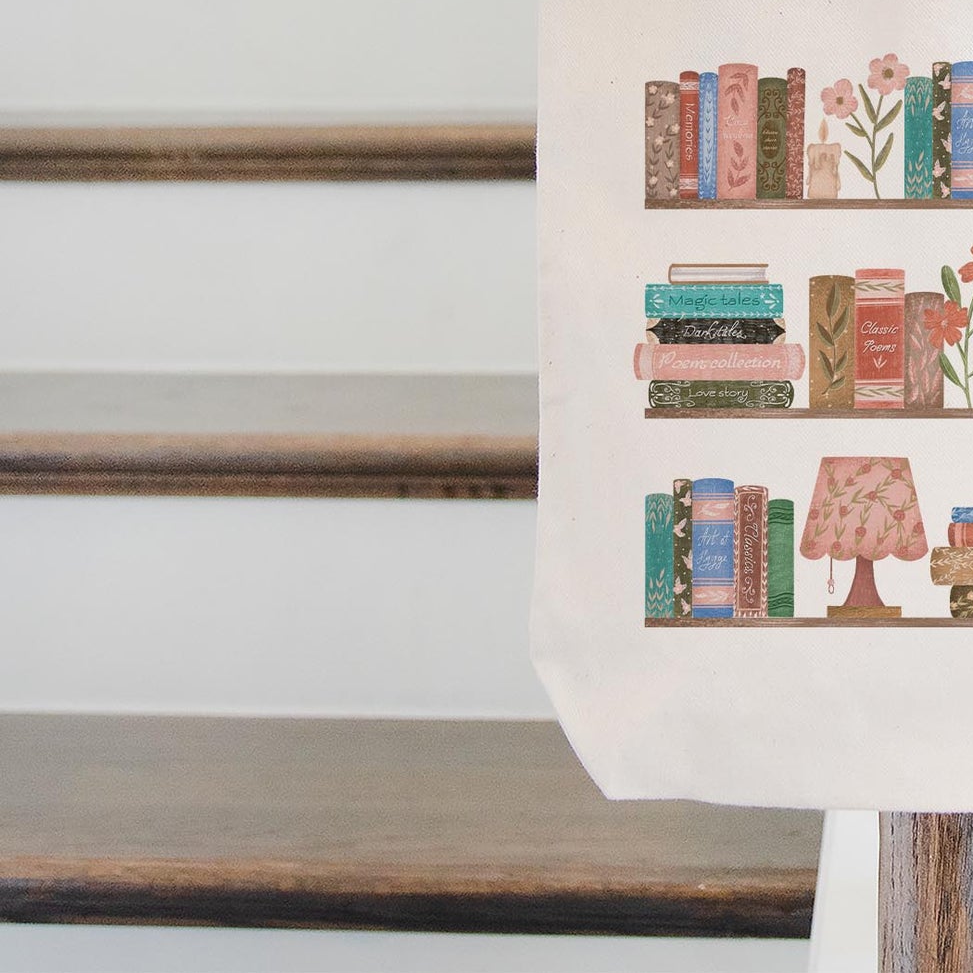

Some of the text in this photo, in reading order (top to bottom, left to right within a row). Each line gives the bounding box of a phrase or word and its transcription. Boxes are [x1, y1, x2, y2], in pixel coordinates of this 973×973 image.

[685, 102, 694, 161] Memories
[668, 292, 761, 311] Magic tales
[860, 320, 899, 335] Classic
[862, 339, 896, 355] Poems
[659, 351, 782, 369] Poems collection
[688, 388, 749, 403] Love story
[743, 523, 758, 575] Classics
